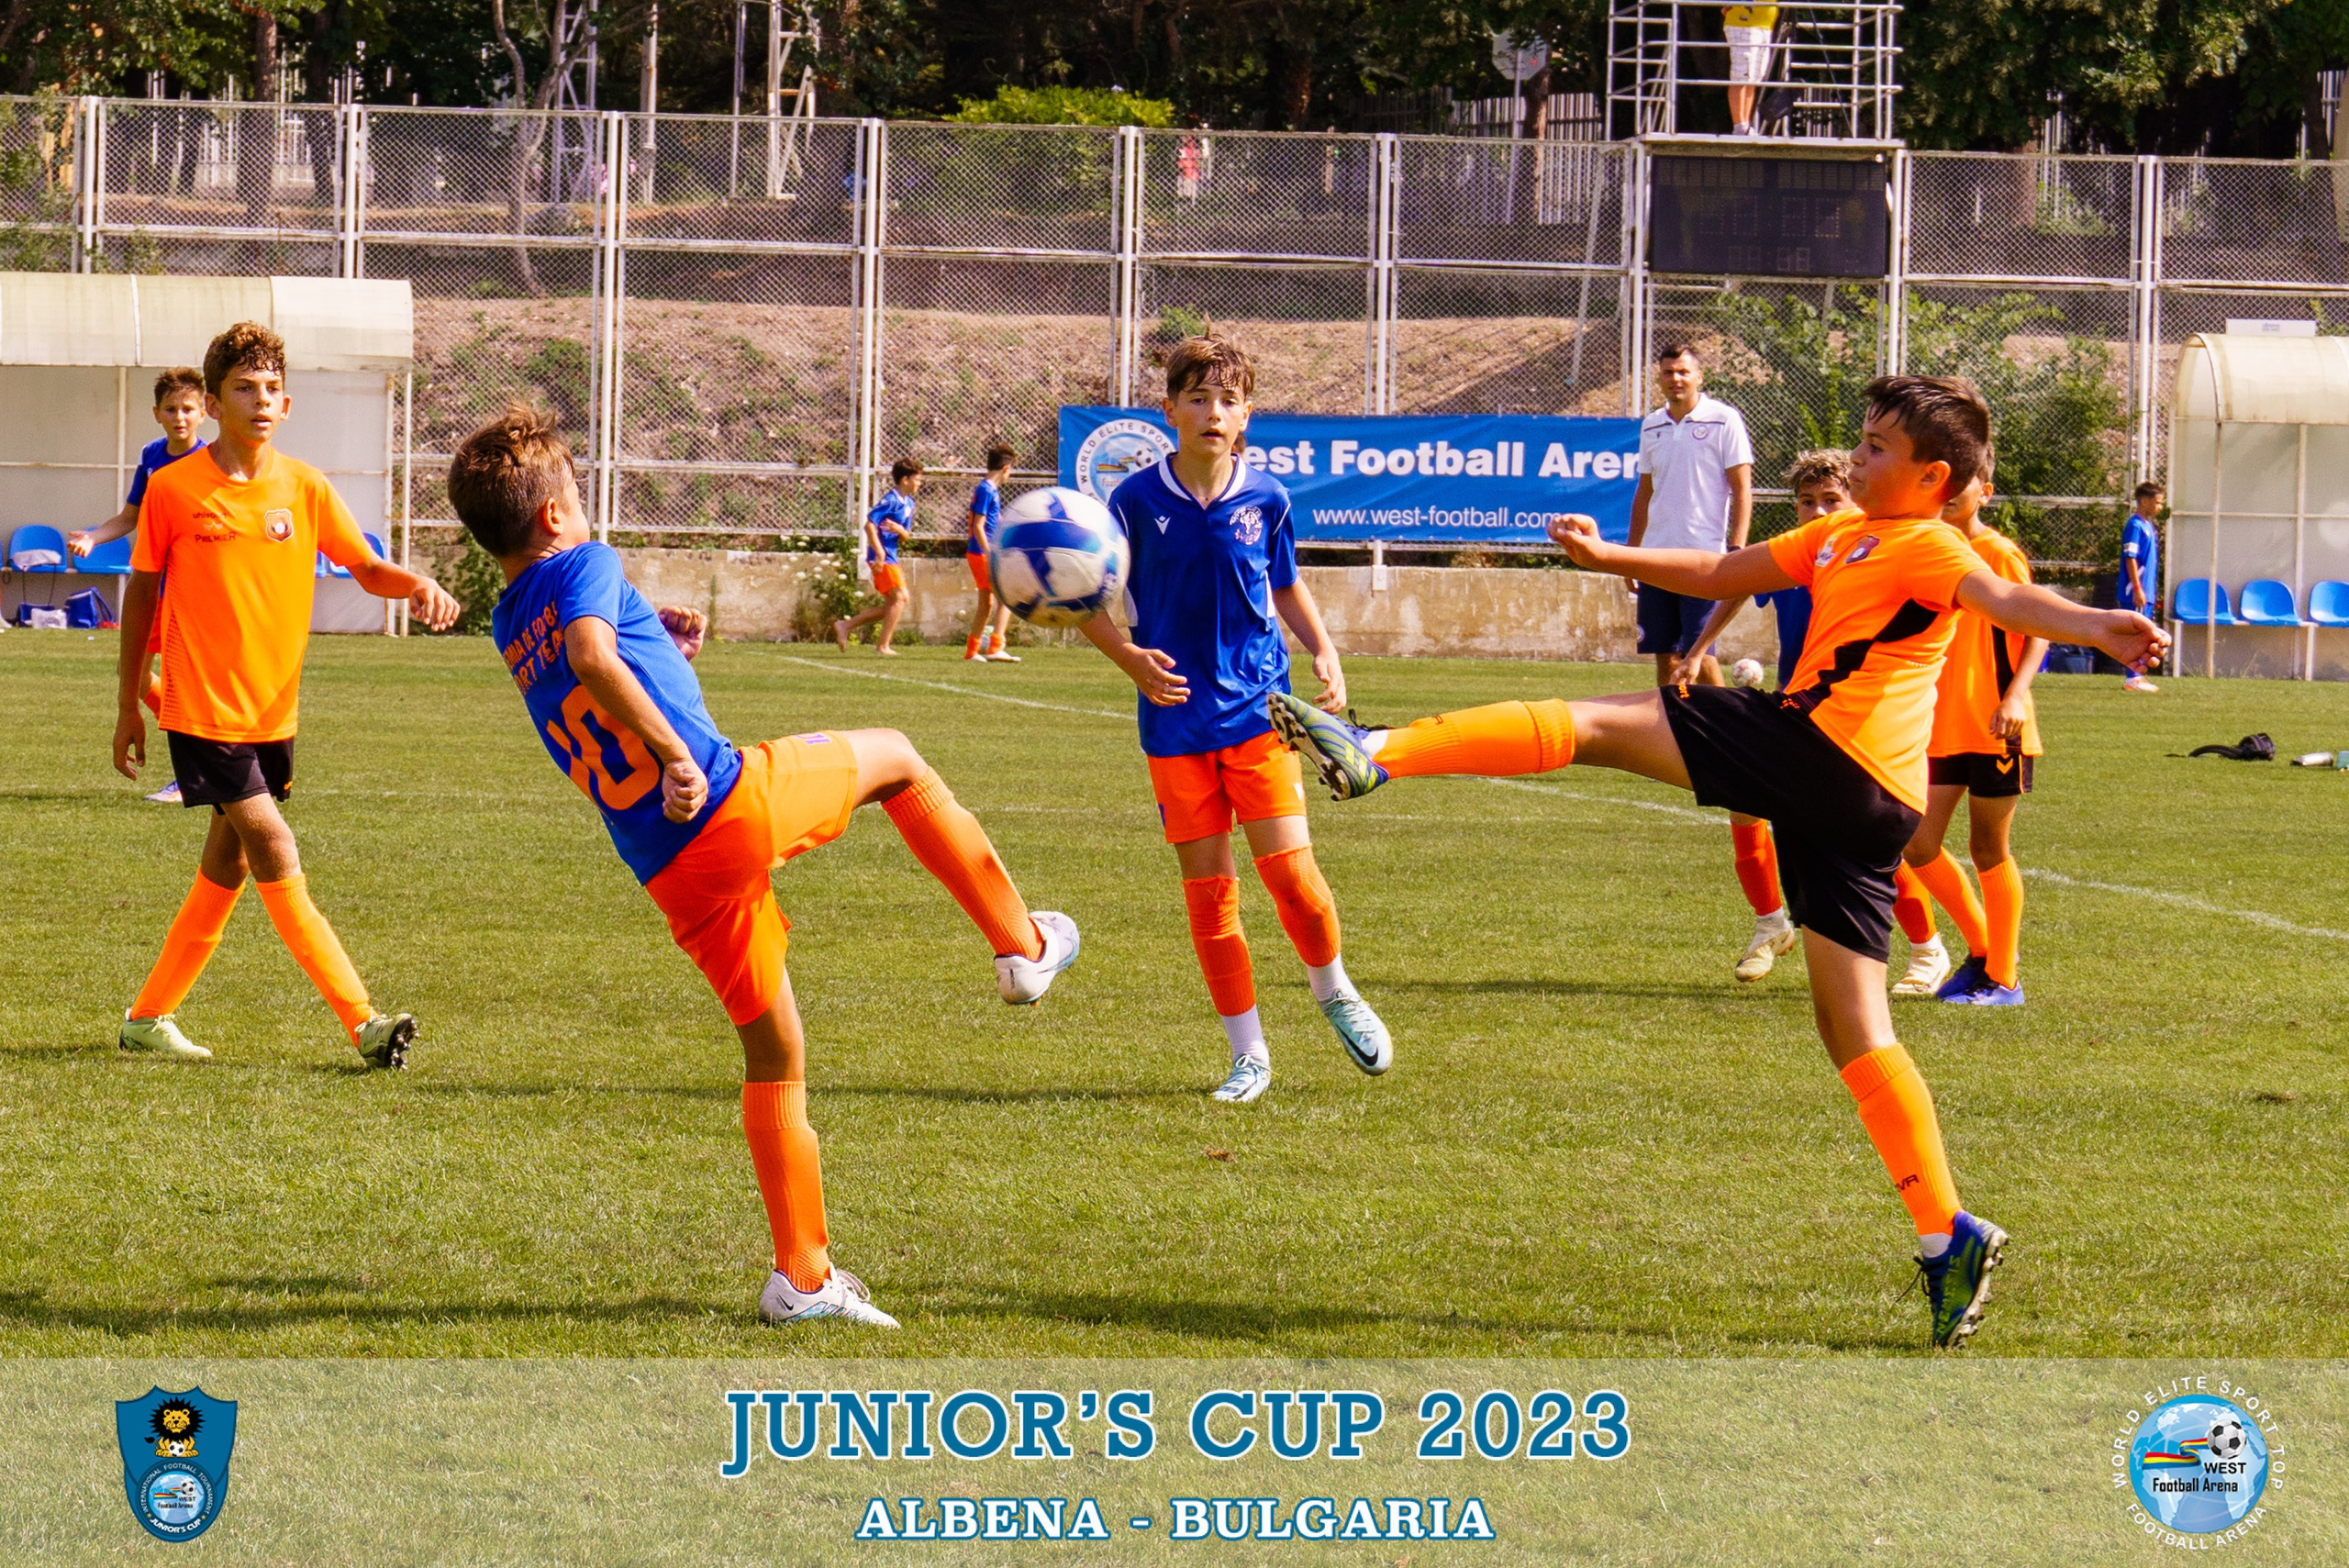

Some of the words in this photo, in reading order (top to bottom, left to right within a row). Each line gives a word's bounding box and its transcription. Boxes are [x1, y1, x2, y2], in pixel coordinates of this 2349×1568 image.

[1079, 439, 1097, 484] WORLD
[1097, 422, 1133, 439] ELITE
[1141, 424, 1172, 452] SPOR
[1244, 440, 1315, 475] est
[1330, 439, 1524, 477] Football
[1538, 442, 1640, 480] Aren
